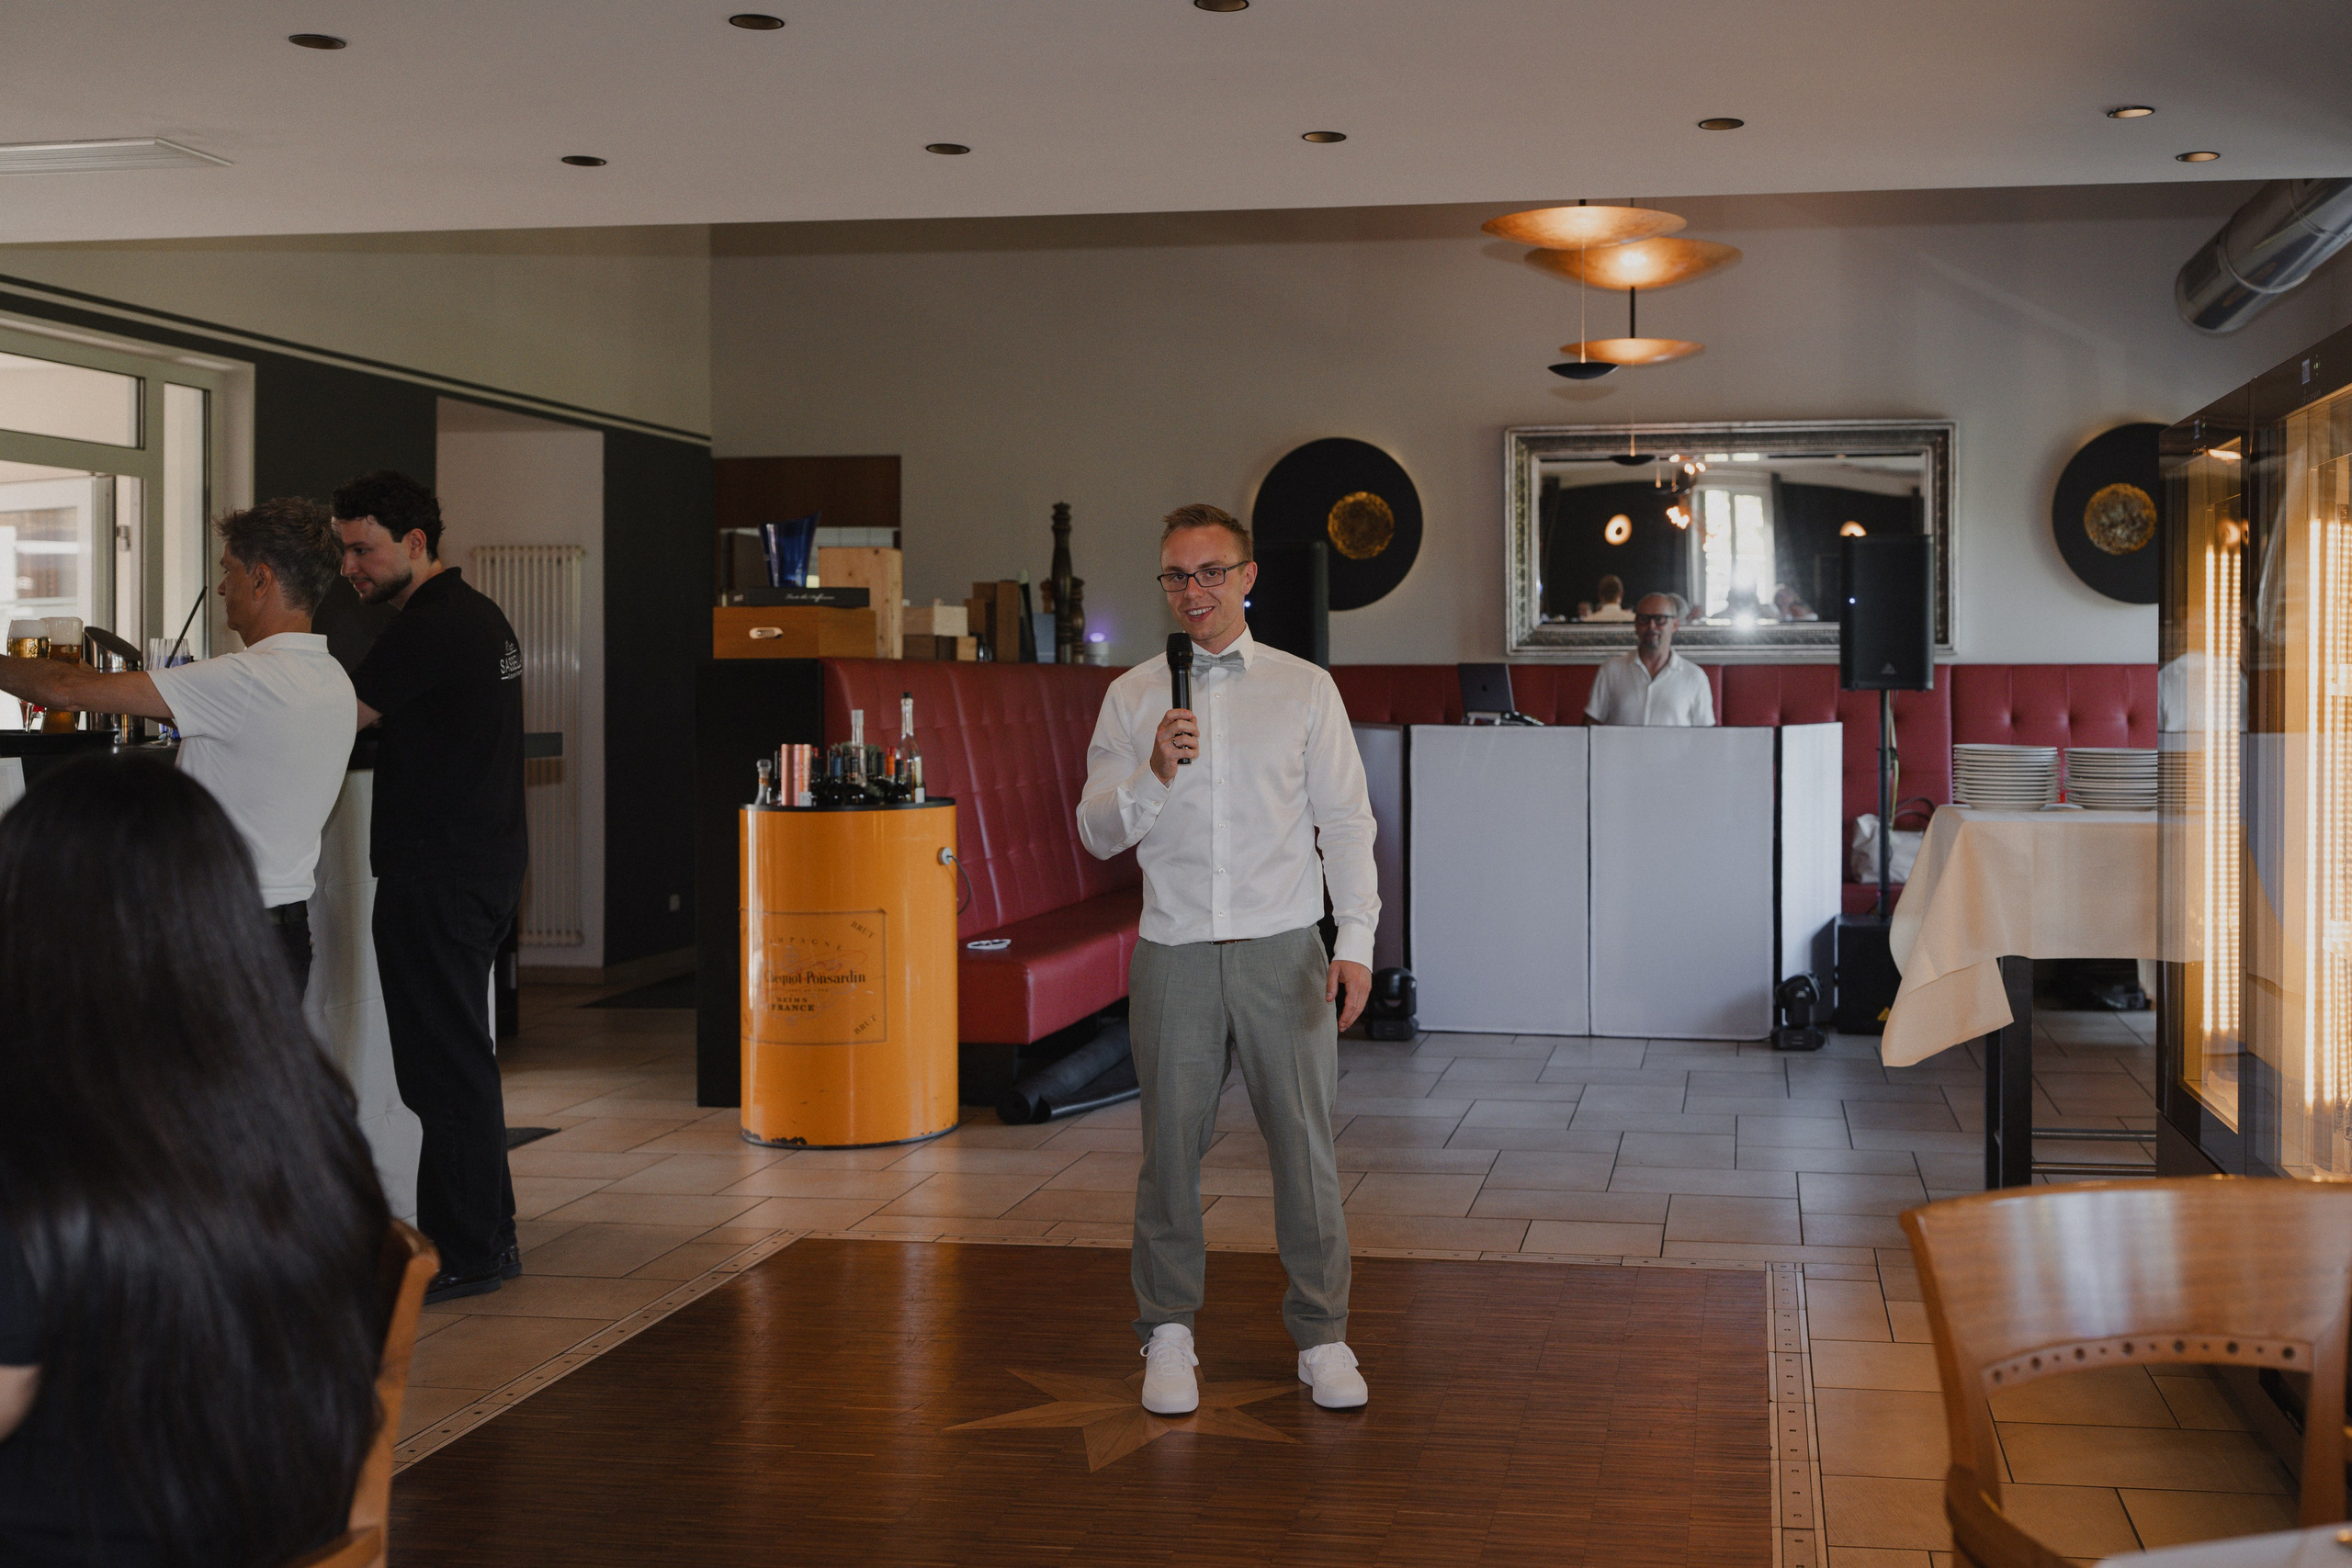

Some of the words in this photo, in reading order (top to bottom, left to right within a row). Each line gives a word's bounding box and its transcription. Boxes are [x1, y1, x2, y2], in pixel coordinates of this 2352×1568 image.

[851, 920, 875, 939] BRUT
[807, 969, 866, 985] Ponsardin
[854, 1014, 876, 1035] BRUT
